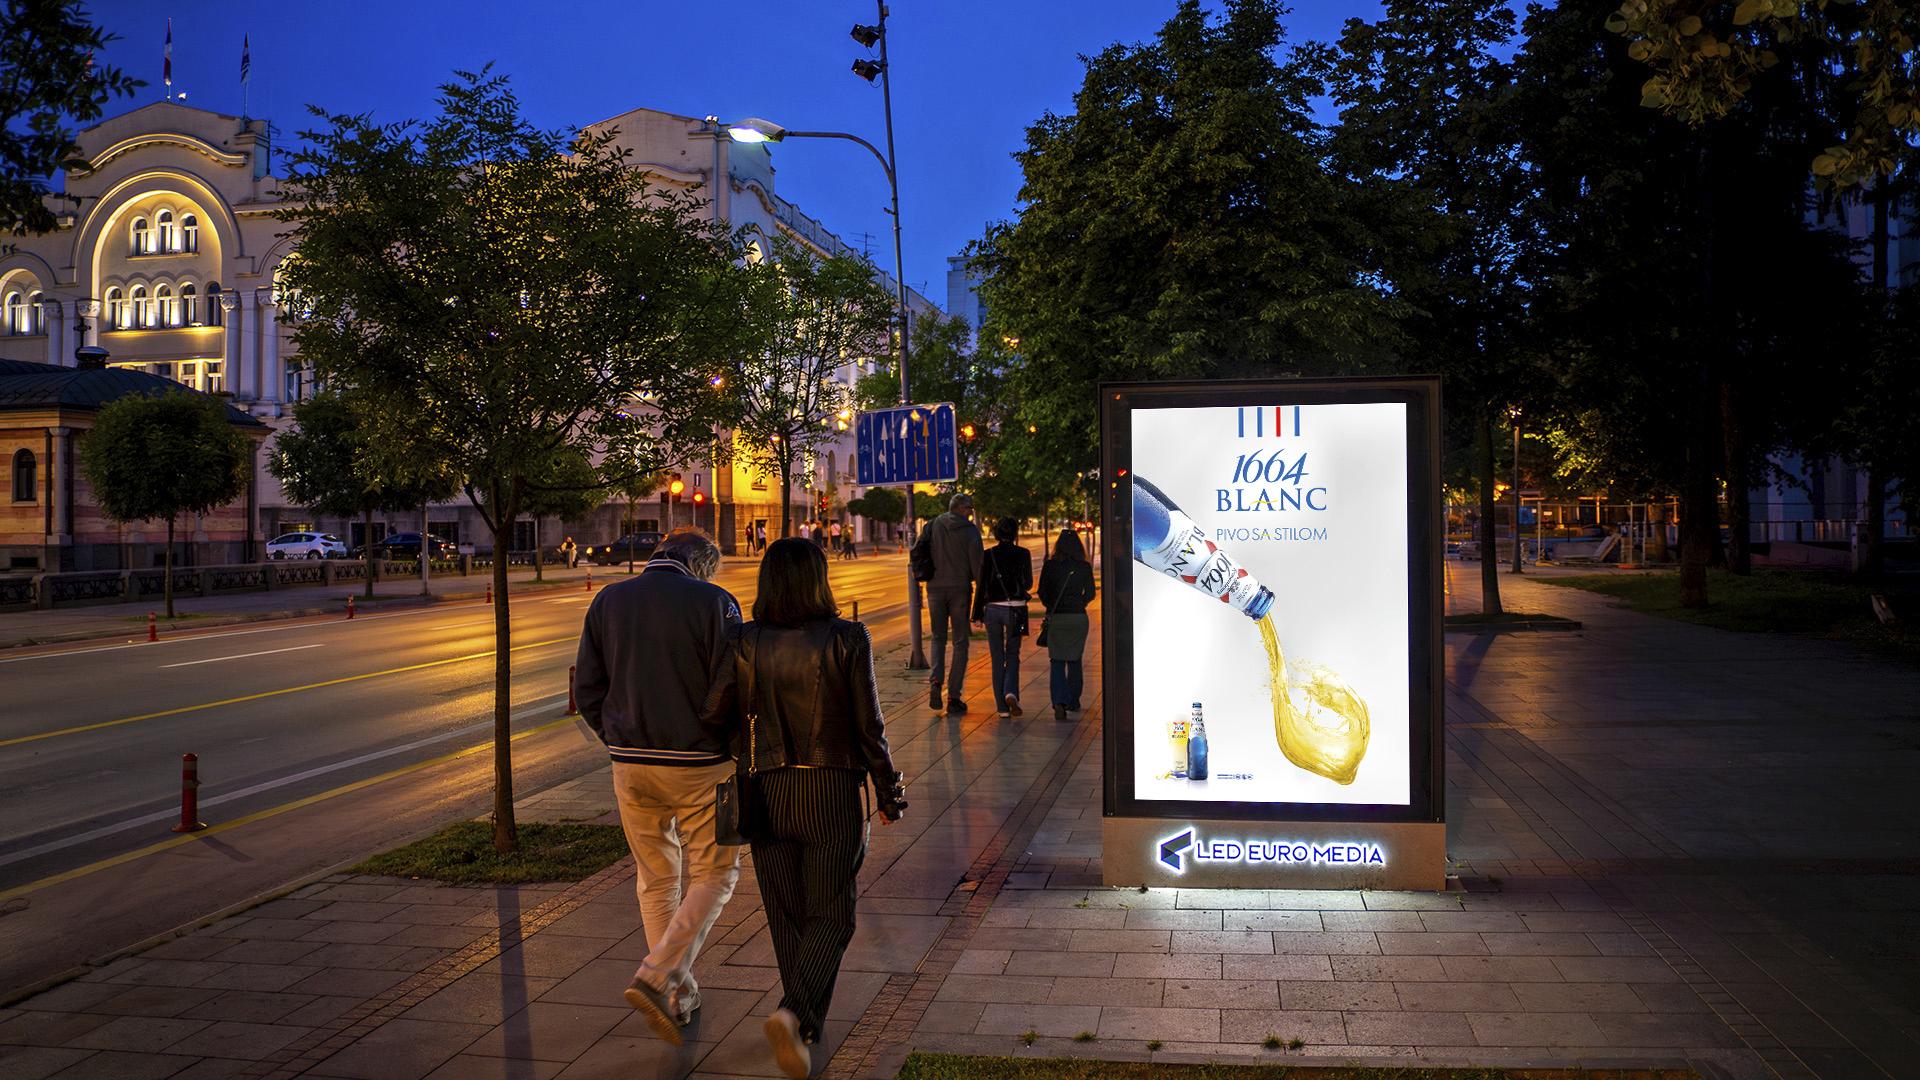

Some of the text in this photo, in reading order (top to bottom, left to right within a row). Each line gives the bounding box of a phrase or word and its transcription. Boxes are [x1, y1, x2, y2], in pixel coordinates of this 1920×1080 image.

[1232, 449, 1310, 485] 1664
[1216, 487, 1328, 512] BLANC
[1216, 527, 1328, 541] PIVO SA STILOM
[1163, 526, 1205, 578] BLANC
[1201, 552, 1233, 593] 1664
[1197, 843, 1384, 864] LED EURO MEDIA
